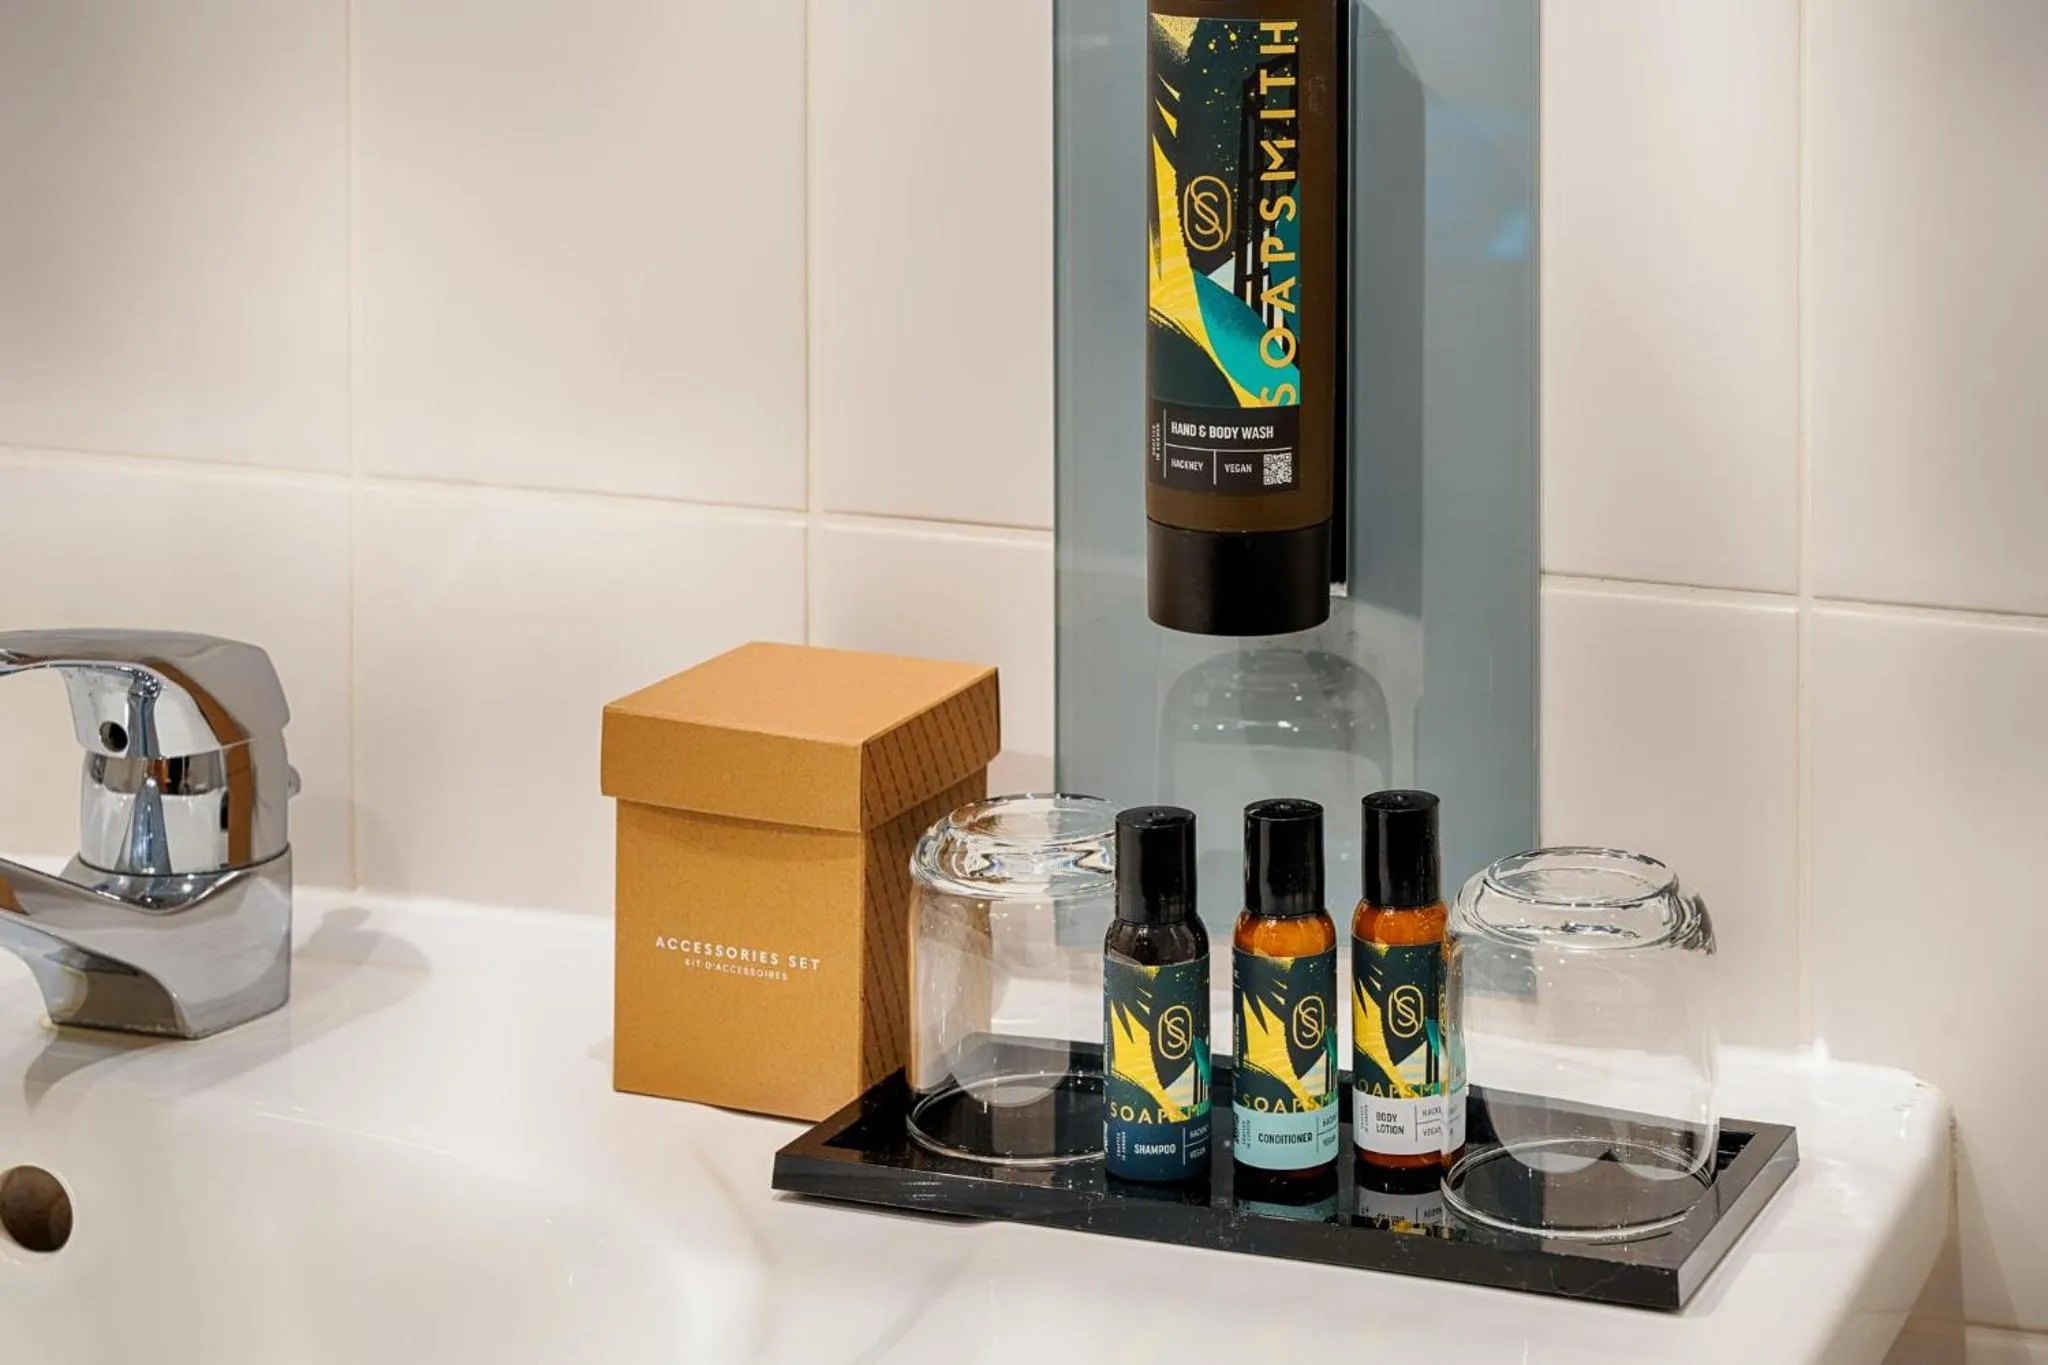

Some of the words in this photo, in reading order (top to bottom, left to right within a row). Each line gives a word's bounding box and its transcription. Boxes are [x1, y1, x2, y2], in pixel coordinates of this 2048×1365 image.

[1259, 21, 1298, 406] SOAPSMITH
[1170, 421, 1197, 437] HAND
[1198, 425, 1206, 437] &
[1209, 425, 1239, 439] BODY
[1241, 426, 1274, 440] WASH
[1170, 458, 1204, 471] HACKNEY
[1224, 463, 1253, 474] VEGAN
[655, 936, 779, 965] ACCESSORIES
[788, 954, 821, 971] SET
[704, 960, 789, 981] D'ACCESSOIRES
[1375, 1111, 1398, 1122] BODY
[1376, 1123, 1405, 1135] LOTION
[1258, 1132, 1313, 1145] CONDITIONER
[1133, 1143, 1177, 1155] SHAMPOO
